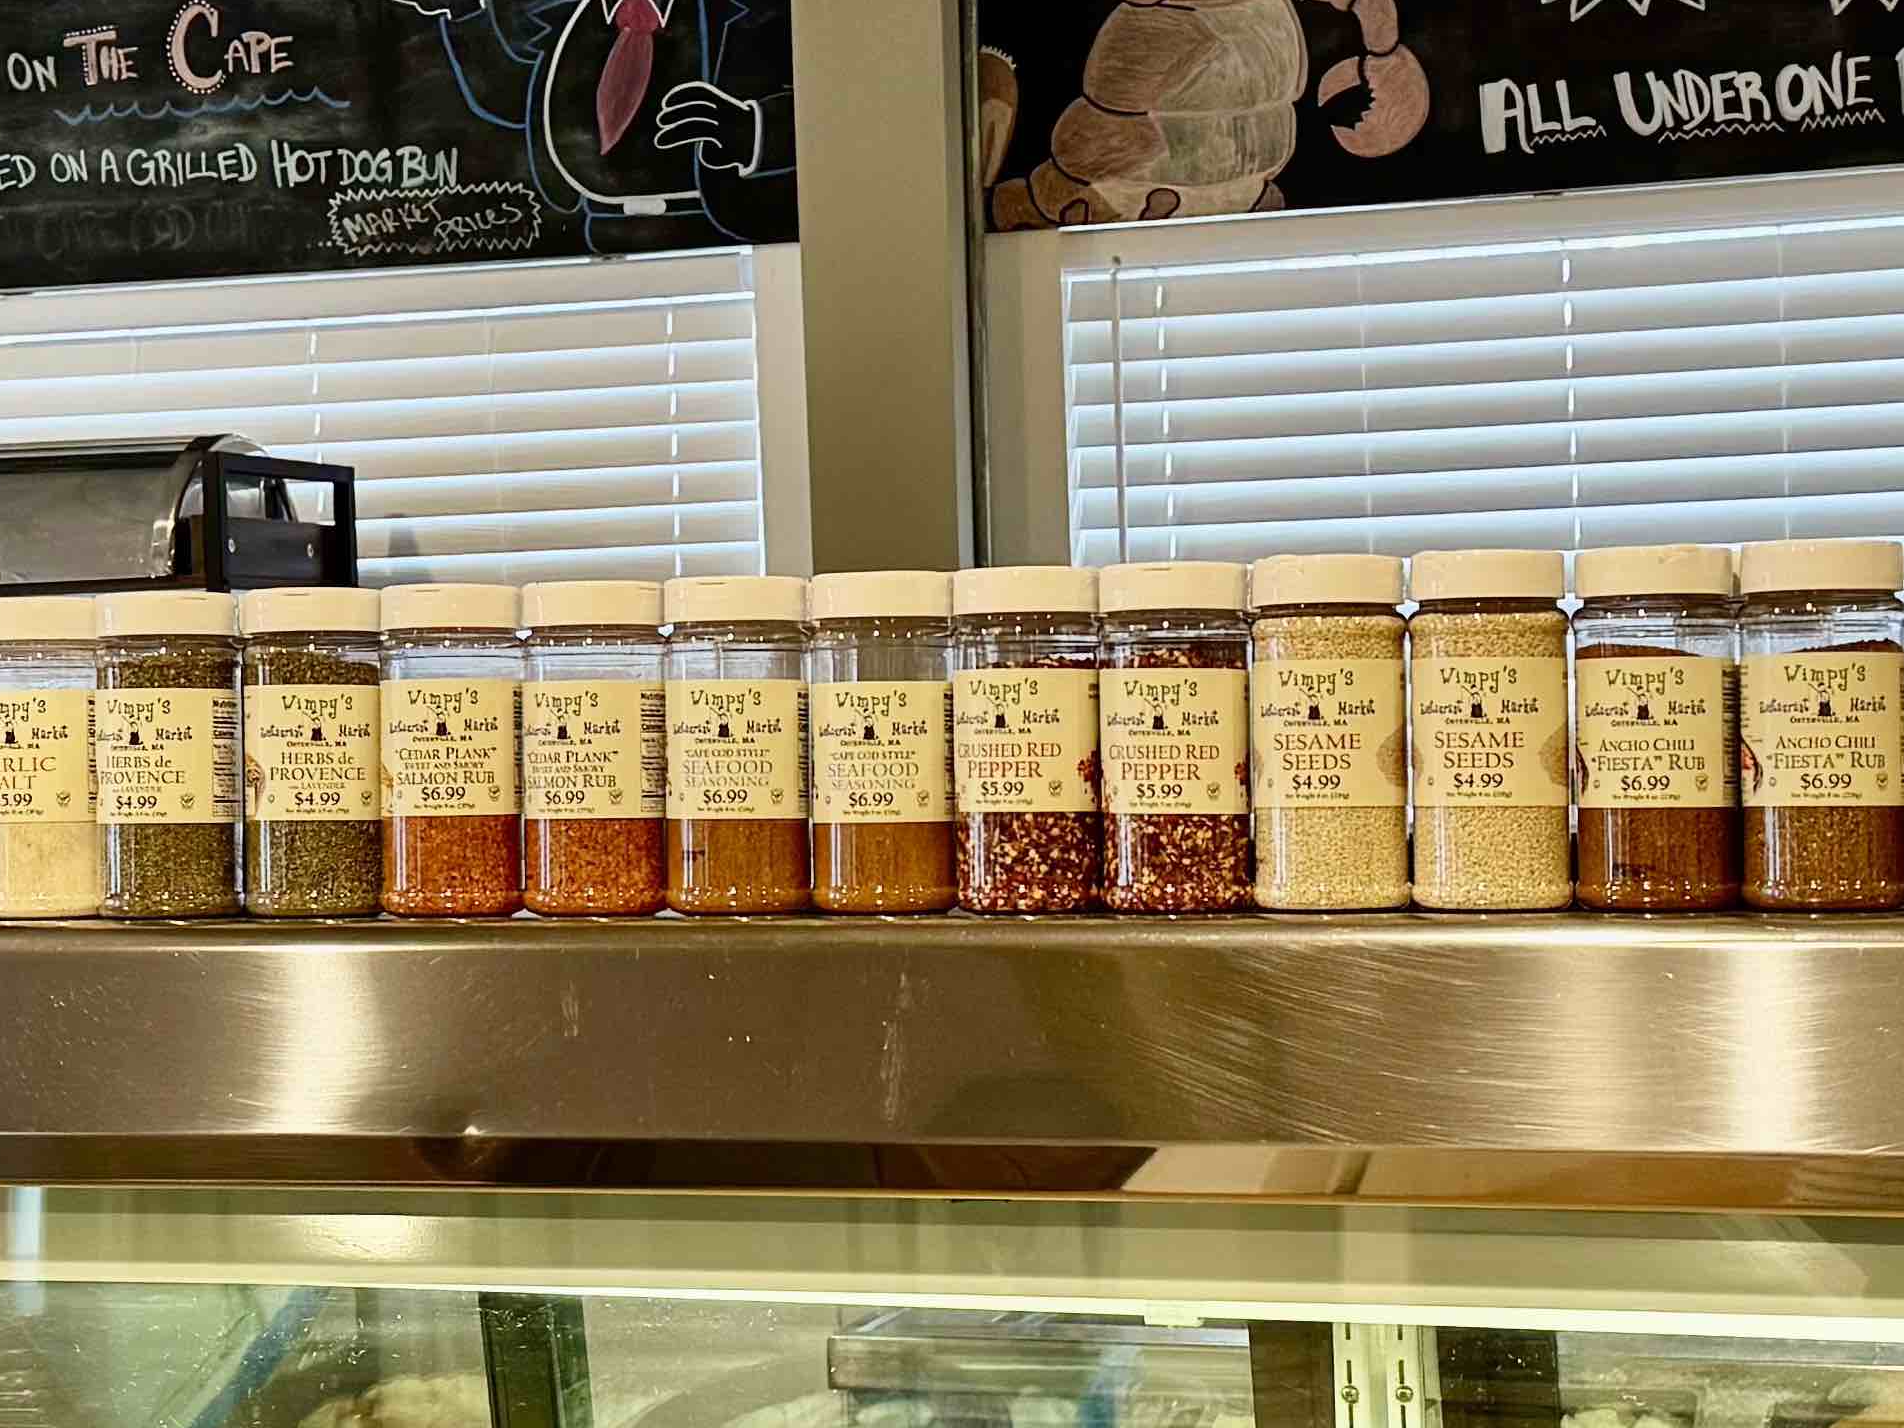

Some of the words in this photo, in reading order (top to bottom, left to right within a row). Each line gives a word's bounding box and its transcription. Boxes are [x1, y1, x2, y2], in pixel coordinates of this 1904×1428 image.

[7, 52, 57, 92] ON
[63, 25, 139, 90] THE
[1614, 68, 1772, 138] UNDER
[1776, 51, 1874, 121] ONE
[50, 151, 88, 186] ON
[99, 150, 123, 184] A
[126, 142, 256, 184] GRILLED
[270, 138, 334, 190] HOT
[338, 149, 392, 184] DOG
[399, 146, 458, 188] BUN
[1434, 731, 1525, 748] SESAME
[1775, 735, 1830, 750] ANCHO
[1835, 735, 1877, 749] CHILI
[282, 752, 333, 764] HERBS
[1109, 745, 1181, 760] CRUSHED
[1186, 745, 1220, 760] RED
[1444, 751, 1514, 769] SEEDS
[1850, 752, 1885, 768] RUB
[270, 768, 366, 780] PROVENCE
[682, 760, 773, 774] SEAFOOD
[1121, 763, 1201, 780] PEPPER
[397, 772, 458, 785] SALMON
[463, 771, 495, 783] RUB
[1454, 773, 1504, 789] $4.99
[1800, 774, 1852, 790] $6.99
[295, 792, 340, 806] $4.99
[422, 787, 466, 802] $6.99
[703, 789, 748, 804] $6.99
[1136, 784, 1183, 799] $5.99
